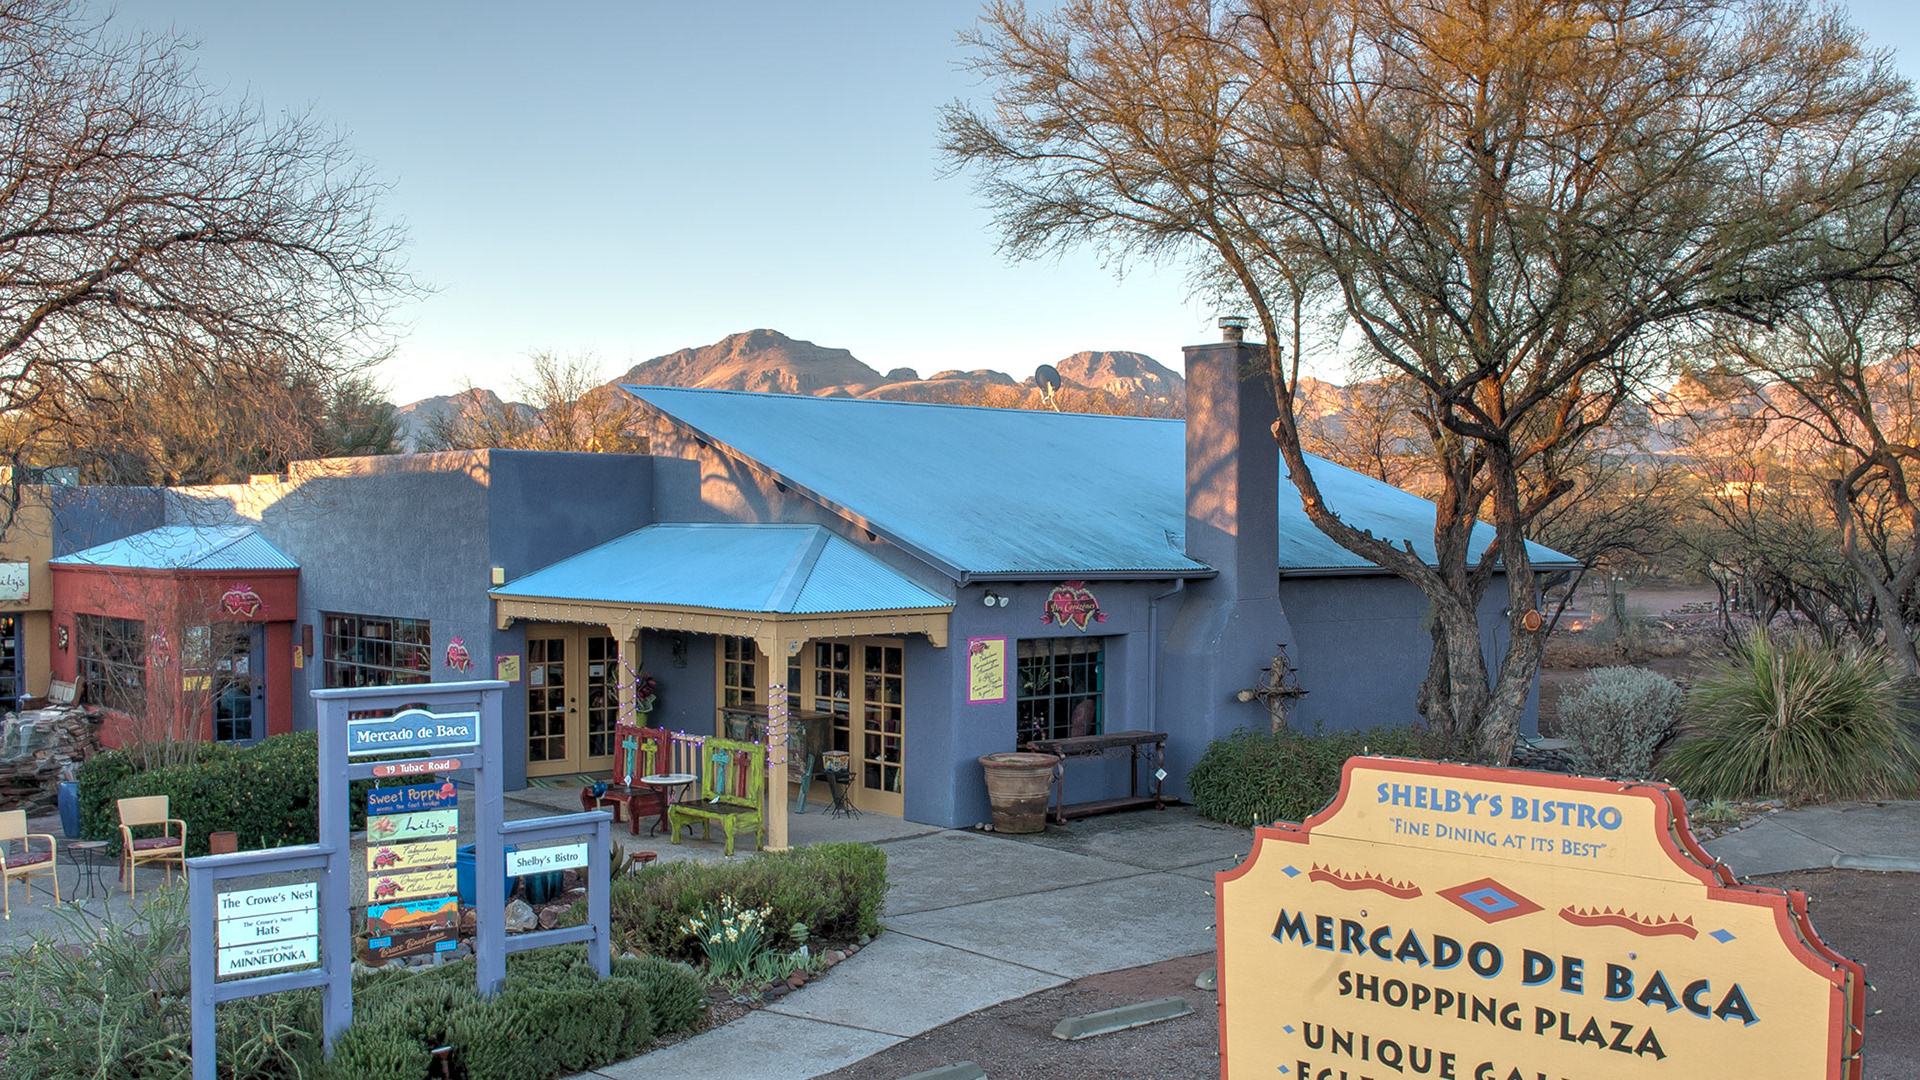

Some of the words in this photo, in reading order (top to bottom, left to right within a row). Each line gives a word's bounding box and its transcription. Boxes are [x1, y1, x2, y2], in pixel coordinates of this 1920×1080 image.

[0, 574, 25, 592] ily's
[357, 728, 413, 743] Mercado
[417, 727, 433, 738] de
[436, 725, 469, 737] Baca
[386, 765, 396, 774] 19
[400, 763, 424, 773] Tubac
[428, 760, 450, 771] Road
[370, 789, 403, 805] Sweet
[408, 788, 440, 802] Poppy
[1377, 783, 1502, 817] SHELBY'S
[1511, 796, 1623, 831] BISTRO
[405, 816, 444, 834] Lily's
[1435, 823, 1497, 847] DINING
[1502, 834, 1526, 849] AT
[1531, 837, 1554, 852] ITS
[403, 844, 438, 855] Fabulous
[407, 853, 452, 865] Furnishings
[517, 855, 551, 867] Shelby's
[555, 852, 578, 862] Bistro
[222, 898, 241, 909] The
[246, 893, 286, 906] Crowe's
[291, 890, 313, 900] Nest
[256, 926, 280, 936] Hats
[230, 950, 306, 969] MINNETONKA
[1271, 908, 1504, 979] MERCADO
[1521, 947, 1584, 995] DE
[1603, 962, 1761, 1027] BACA
[1338, 970, 1521, 1032] SHOPPING
[1534, 1006, 1667, 1061] PLAZA
[1303, 1021, 1455, 1080] UNIQUE
